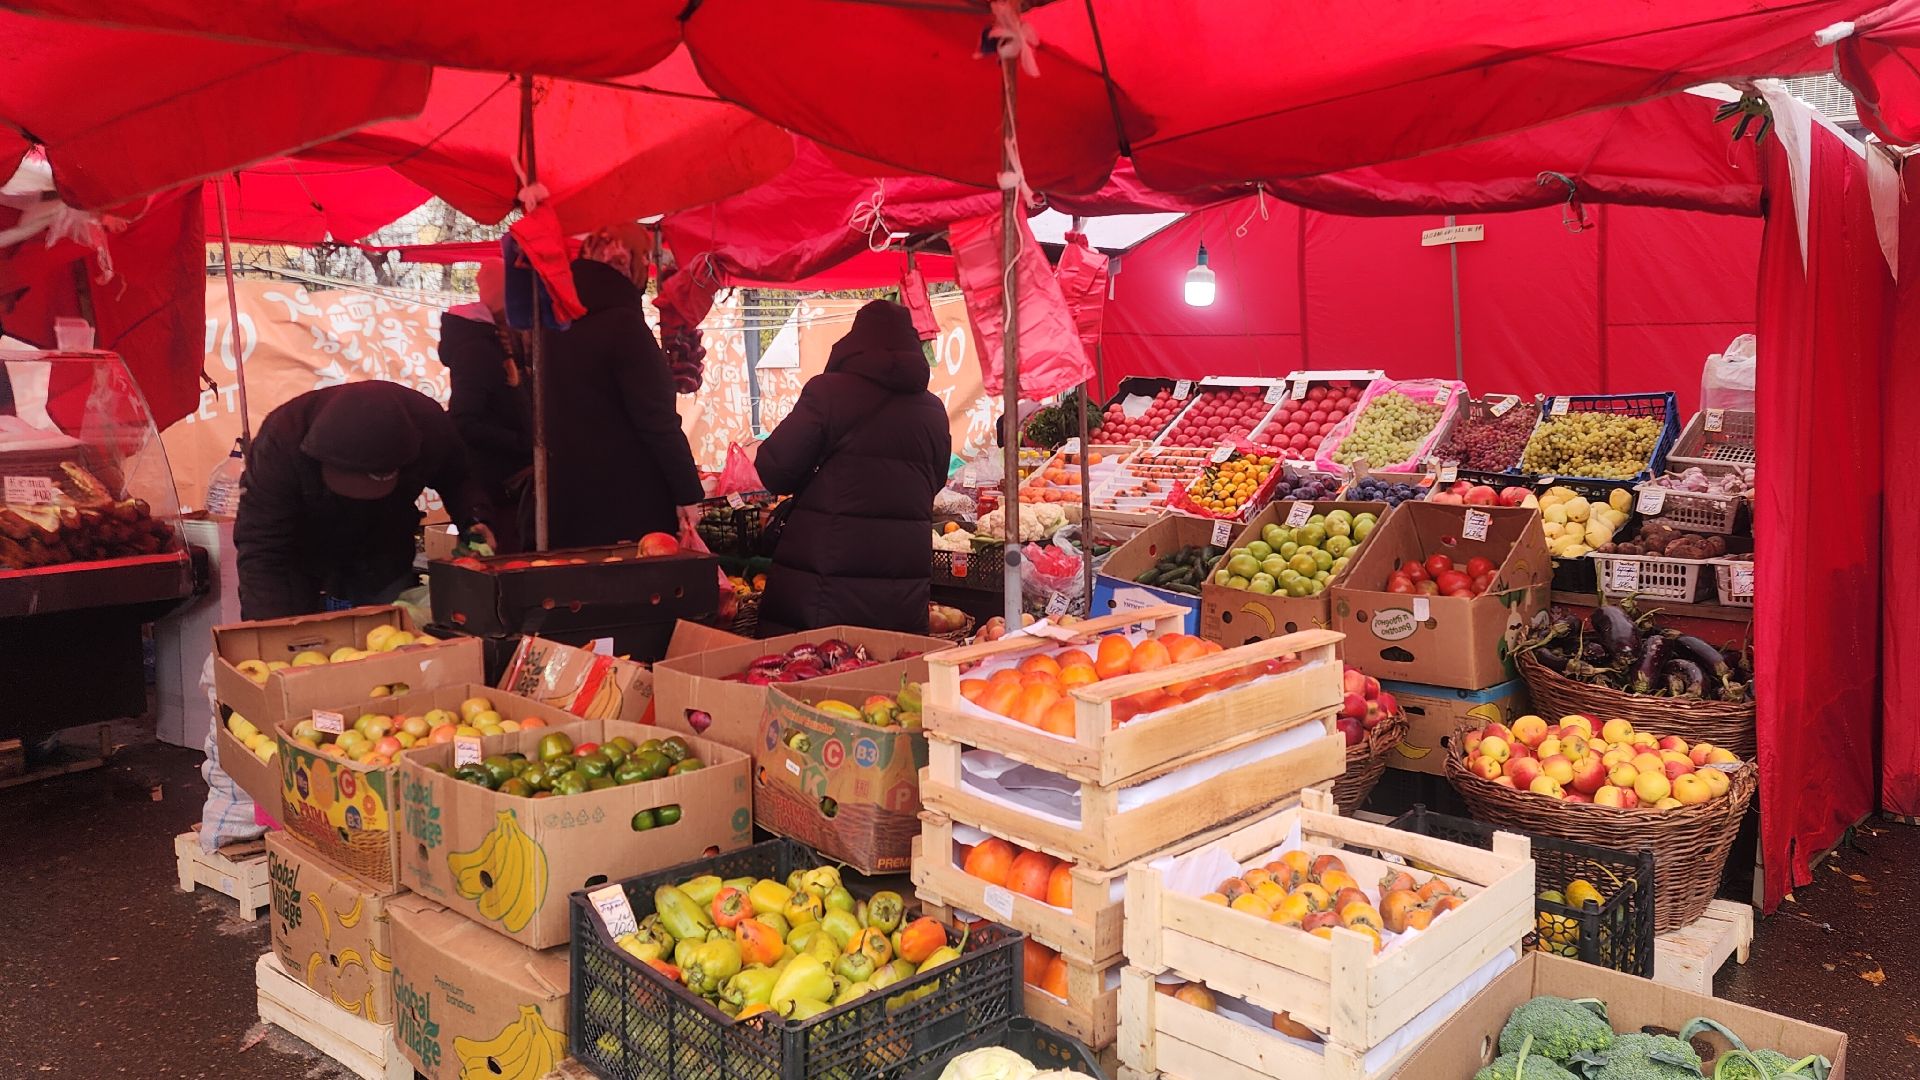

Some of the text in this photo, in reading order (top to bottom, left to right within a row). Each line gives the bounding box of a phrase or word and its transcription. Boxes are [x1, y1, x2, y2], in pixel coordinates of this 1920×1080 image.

[856, 746, 877, 762] B3
[341, 773, 353, 795] C
[347, 814, 361, 829] B3
[269, 850, 301, 890] Global
[271, 879, 302, 929] Village
[392, 967, 431, 1023] Global
[433, 974, 465, 996] Premium
[446, 993, 476, 1015] bananas
[396, 1001, 441, 1067] Village
